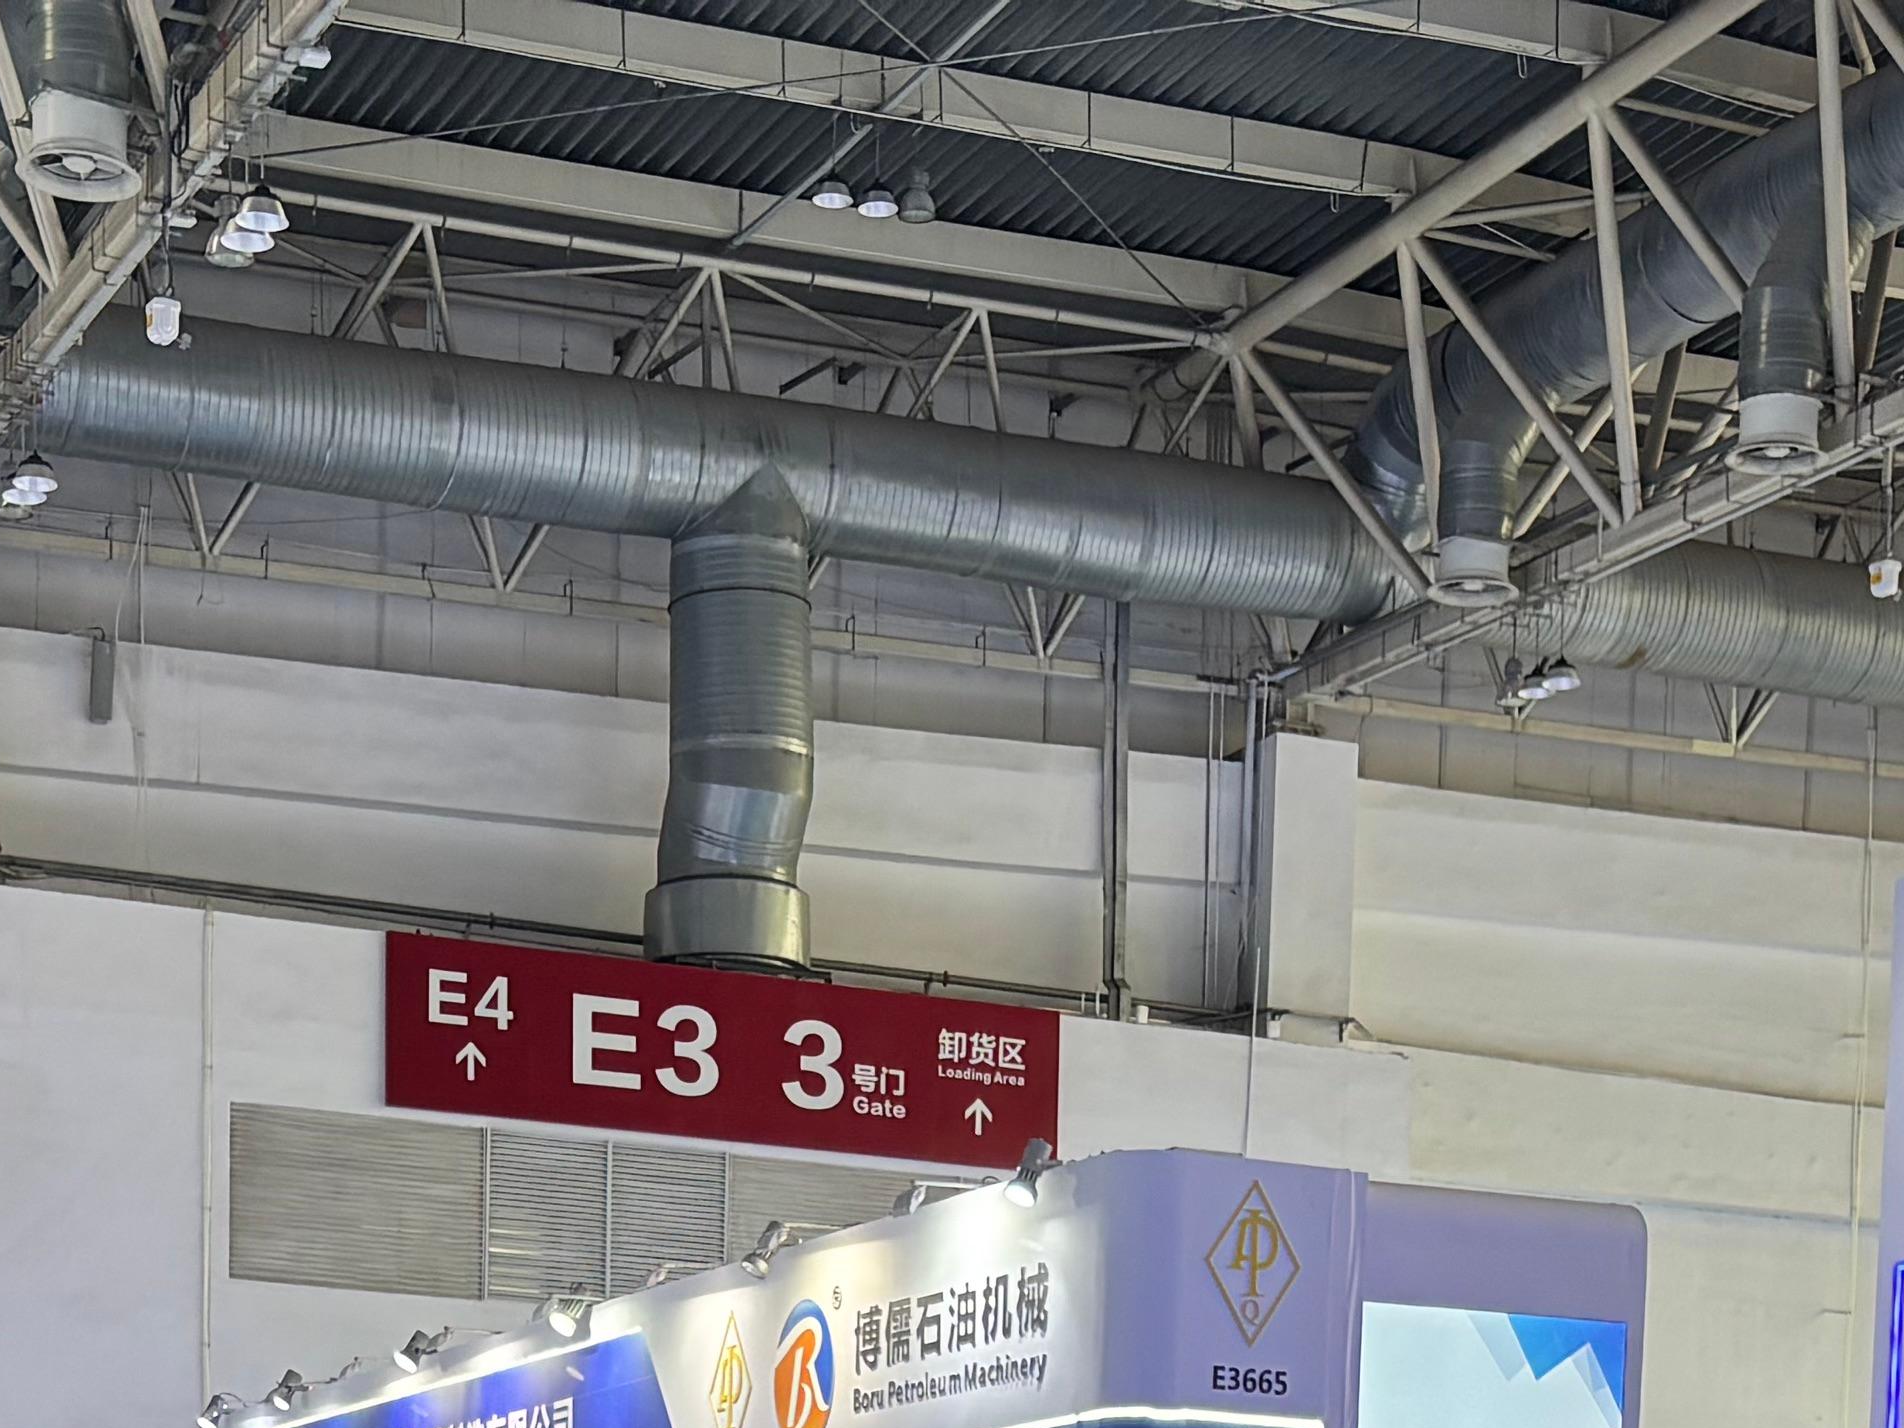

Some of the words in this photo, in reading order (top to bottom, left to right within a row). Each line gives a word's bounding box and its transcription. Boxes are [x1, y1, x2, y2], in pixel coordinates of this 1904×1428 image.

[428, 968, 514, 1031] E4
[572, 992, 720, 1097] E3
[781, 1019, 844, 1110] 3
[938, 1028, 1026, 1070] 卸货区
[852, 1063, 906, 1096] 号门
[938, 1065, 991, 1085] Loading
[993, 1070, 1025, 1087] Area
[853, 1096, 906, 1118] Gate
[854, 1262, 1049, 1376] 博儒石油机械
[853, 1386, 885, 1414] Boru
[887, 1374, 963, 1407] Petroleum
[964, 1353, 1049, 1392] Machinery
[1211, 1364, 1289, 1396] E3665
